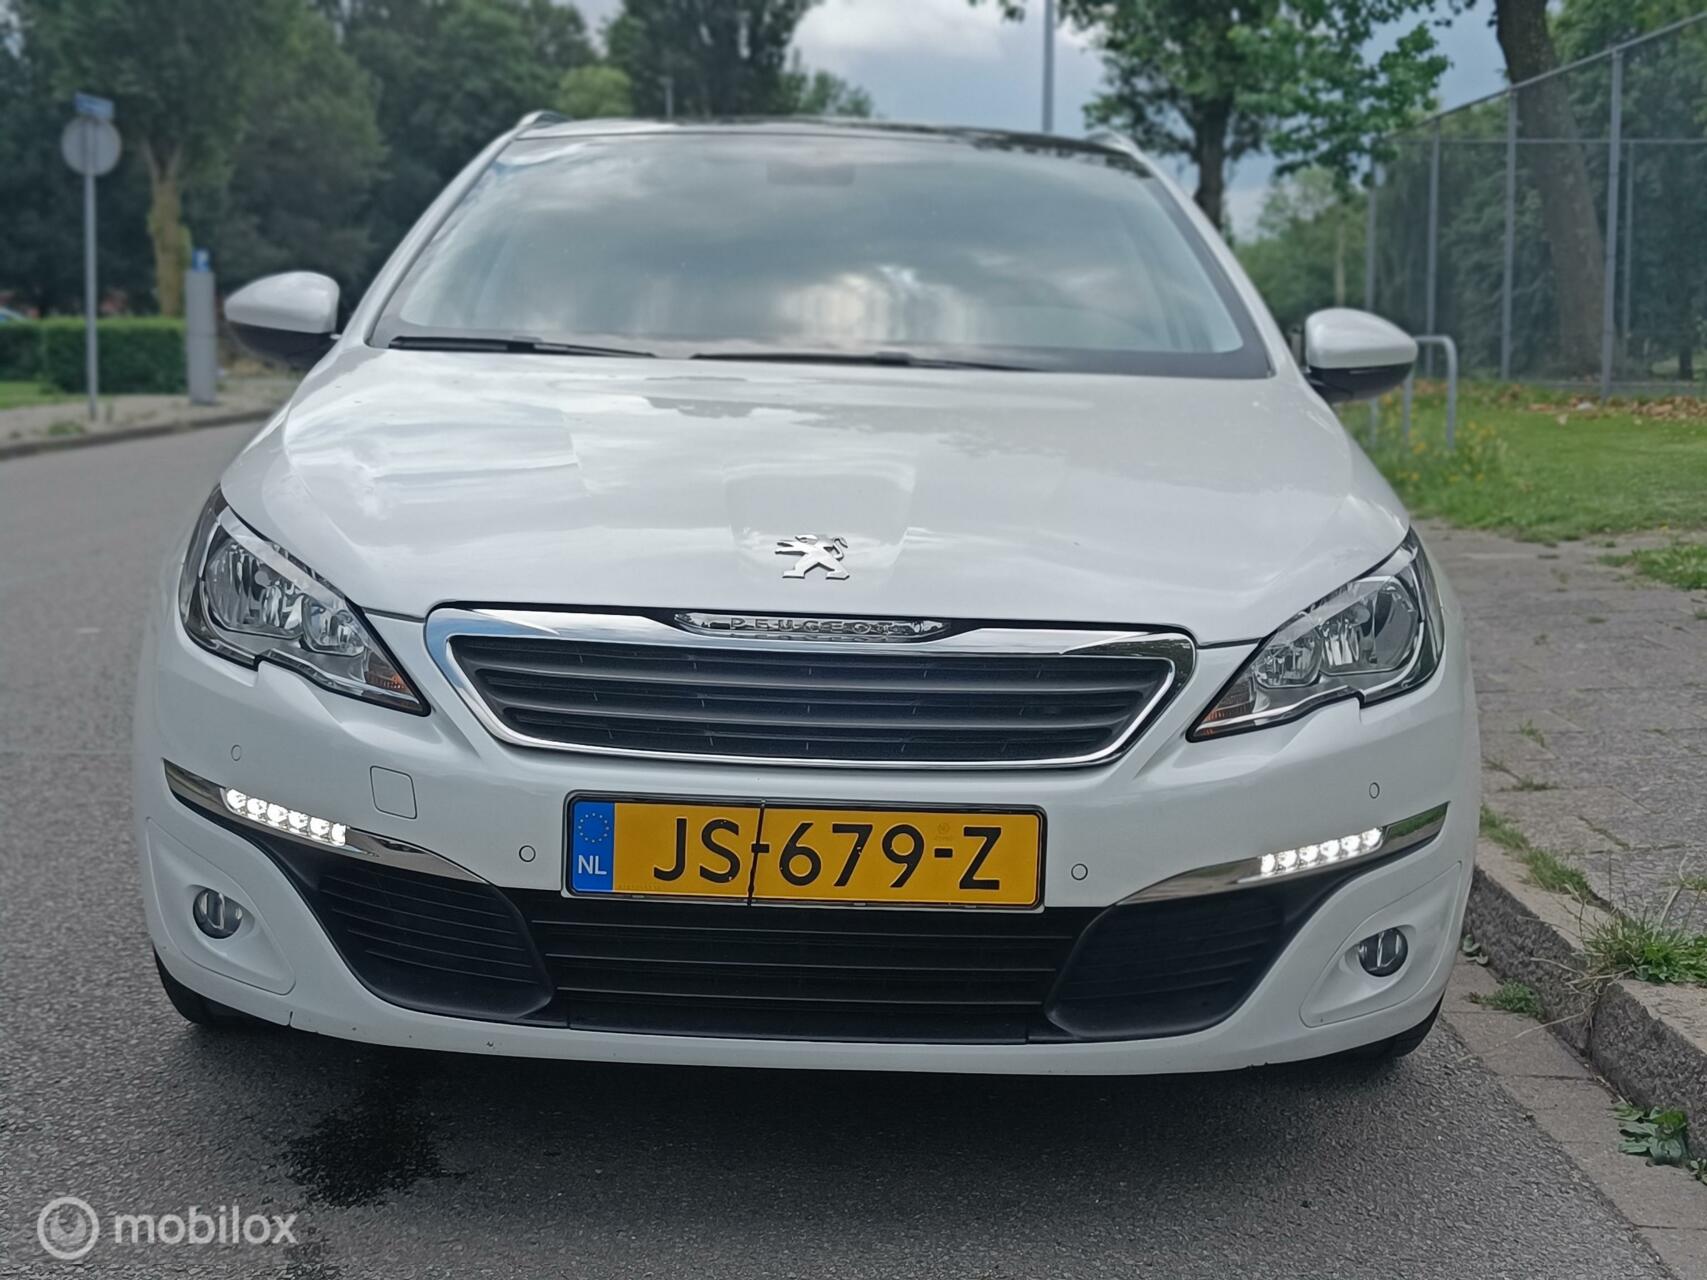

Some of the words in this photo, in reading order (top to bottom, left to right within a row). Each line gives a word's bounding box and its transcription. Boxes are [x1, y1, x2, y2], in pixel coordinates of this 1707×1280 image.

[730, 617, 893, 635] PEUGEOT
[653, 817, 1003, 891] JS-679-Z
[577, 855, 608, 876] NL
